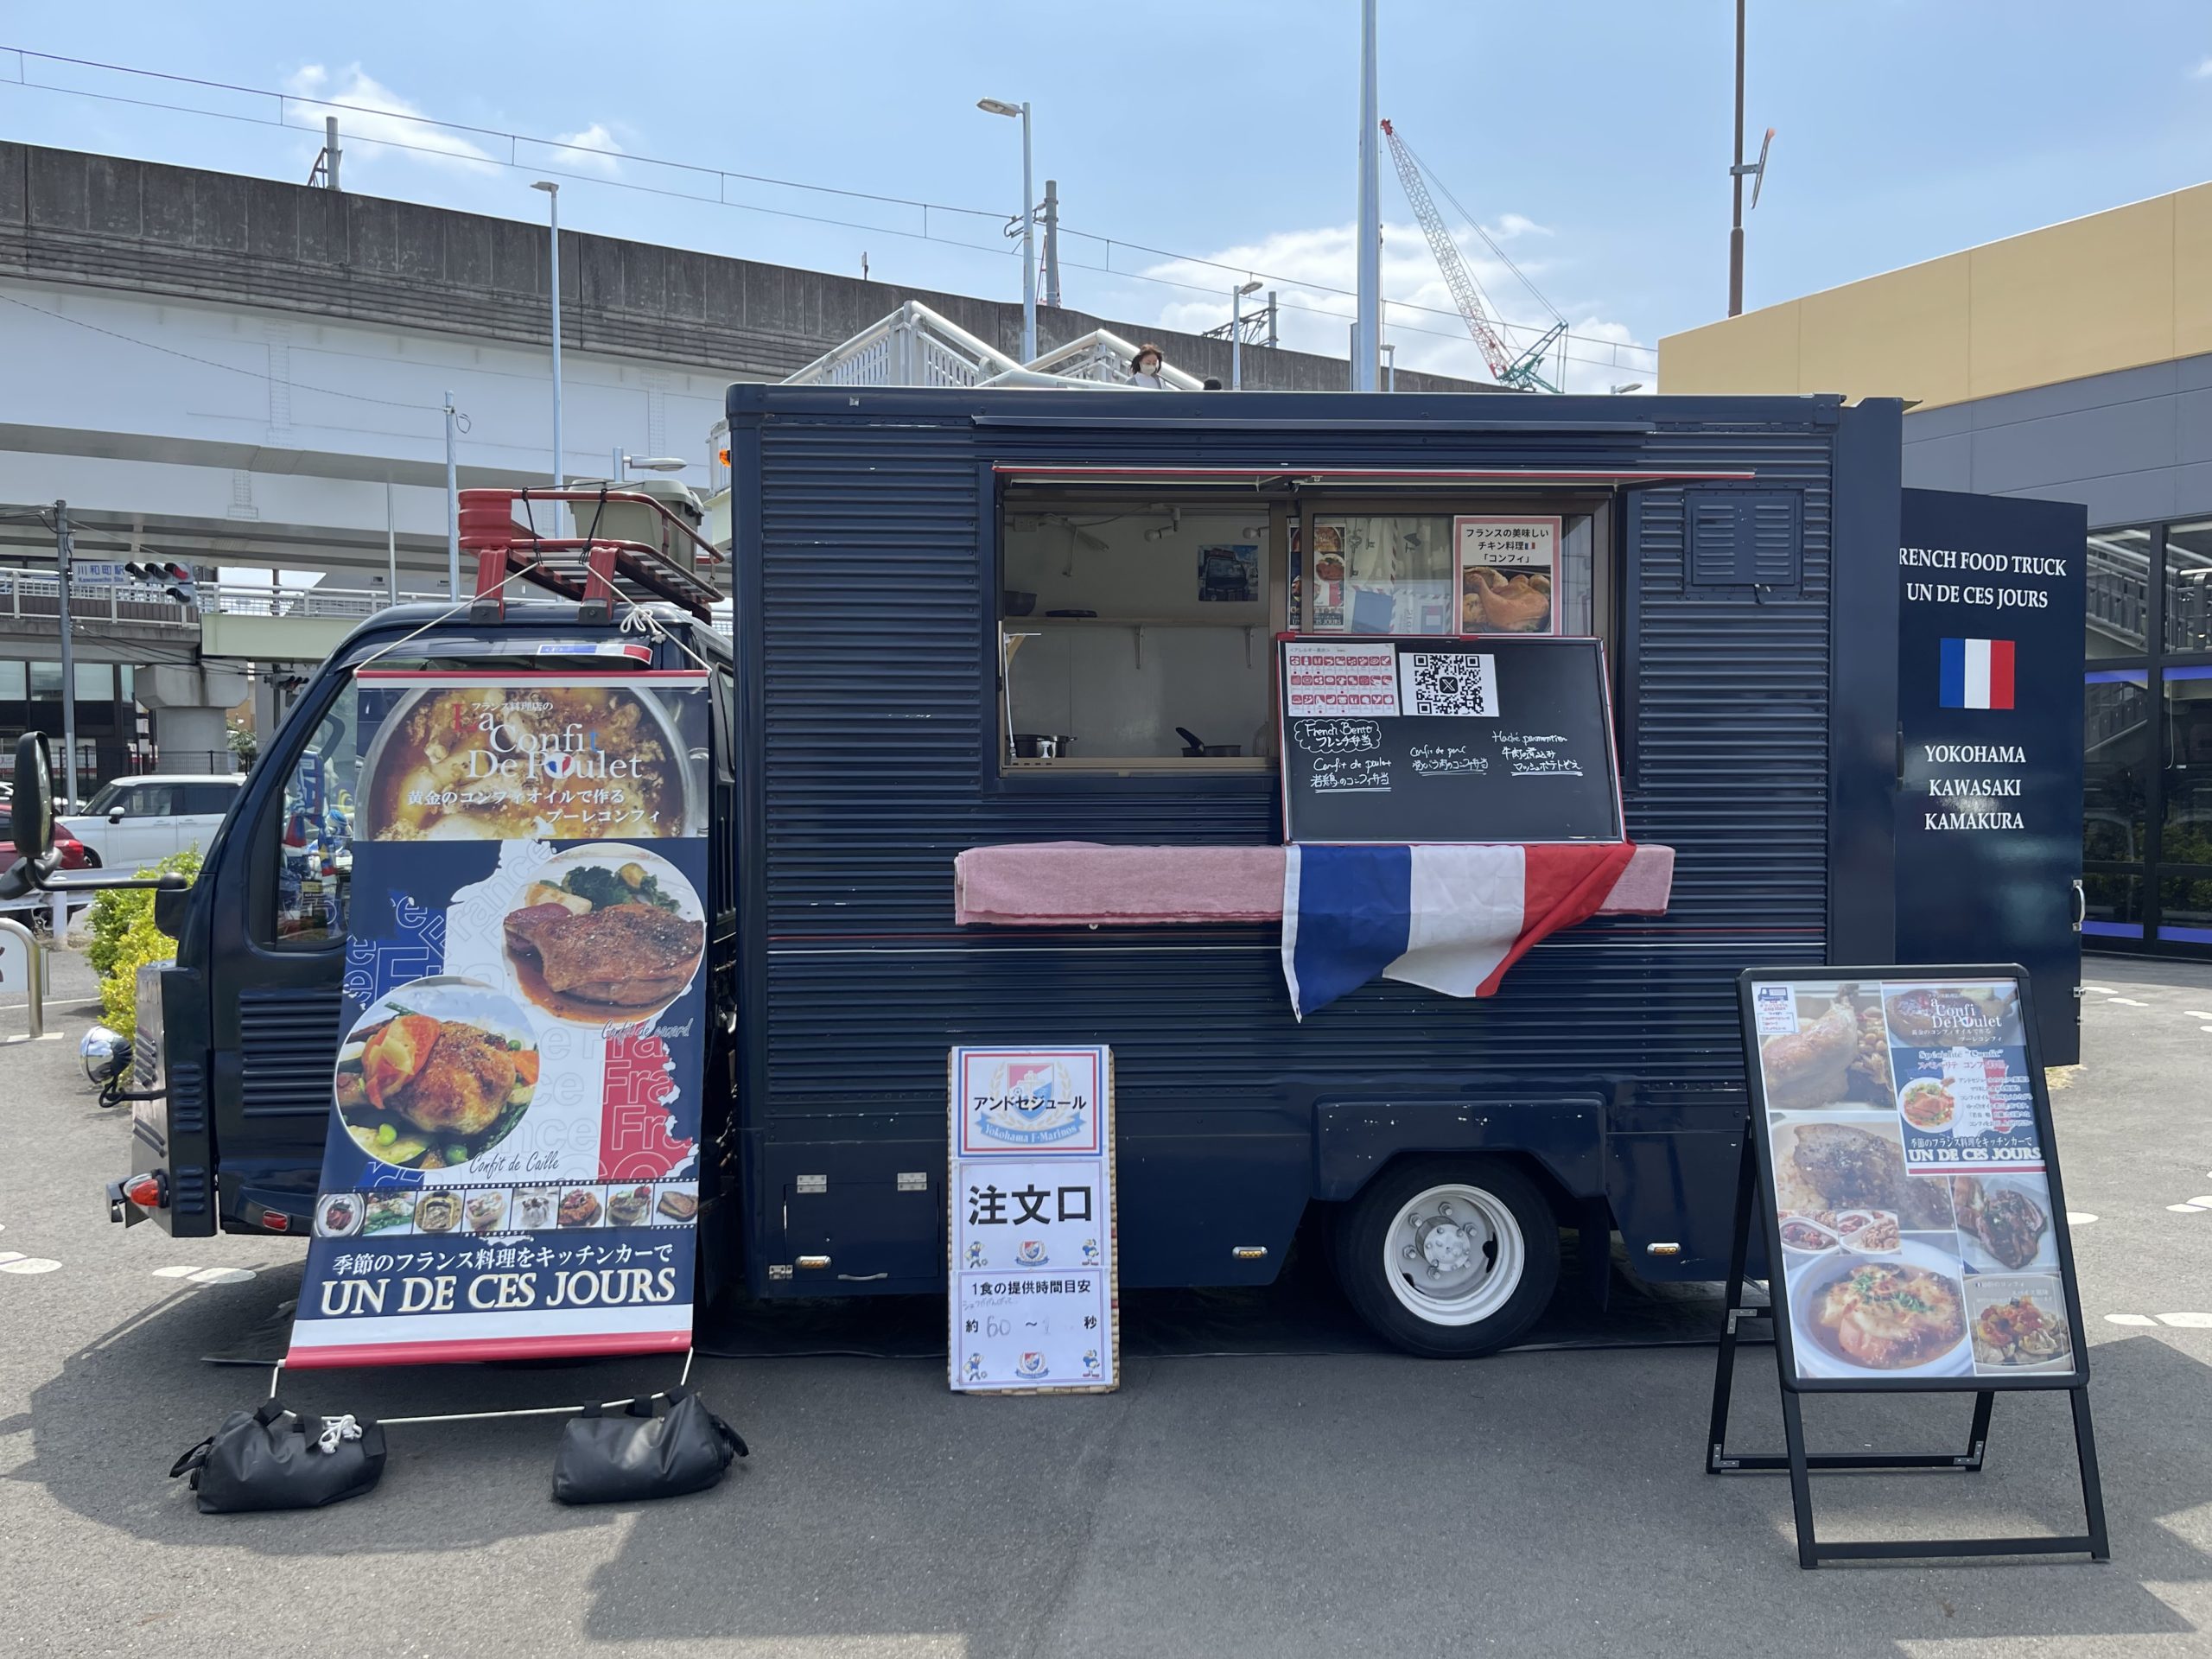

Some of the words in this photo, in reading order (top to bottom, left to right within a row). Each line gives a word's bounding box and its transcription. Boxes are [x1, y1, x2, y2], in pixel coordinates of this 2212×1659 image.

[1465, 528, 1549, 538] フランスの美味しい
[1478, 541, 1524, 550] チキン料理
[1484, 553, 1529, 563] 「コンフィ」
[1960, 551, 2008, 572] FOOD
[2011, 556, 2067, 577] TRUCK
[78, 564, 125, 575] 川和町駅
[1906, 582, 1933, 602] UN
[1936, 584, 1960, 603] DE
[1962, 586, 1993, 606] CES
[1996, 588, 2048, 610] JOURS
[471, 702, 554, 712] フランス料理店の
[489, 722, 599, 753] Confit
[1305, 722, 1338, 737] French
[1339, 721, 1373, 735] Bento
[1315, 734, 1372, 748] フレンチ弁当
[1923, 745, 2026, 764] YOKOHAMA
[467, 749, 518, 779] De
[1313, 757, 1347, 772] Confit
[1350, 759, 1363, 769] de
[407, 788, 626, 806] 黄金のコンフィオイルで作る
[1929, 779, 2021, 797] KAWASAKI
[1923, 812, 2024, 830] KAMAKURA
[974, 1096, 1087, 1111] アンドセジュール
[985, 1124, 1029, 1143] Yokohama
[1908, 1148, 1934, 1162] UN
[1938, 1147, 1960, 1162] DE
[1961, 1147, 1988, 1161] CES
[1992, 1147, 2042, 1160] JOURS
[469, 1153, 506, 1179] Confit
[508, 1155, 522, 1170] de
[525, 1151, 560, 1172] Caille
[968, 1184, 1092, 1226] 注文口
[332, 1243, 673, 1276] 季節のフランス料理をキッチンカーで
[321, 1277, 391, 1316] UN
[397, 1275, 458, 1313] DE
[467, 1272, 537, 1309] CES
[546, 1267, 676, 1306] JOURS
[972, 1279, 1091, 1296] 1食の提供時間目安
[965, 1318, 979, 1333] 約
[1084, 1315, 1097, 1330] 秒
